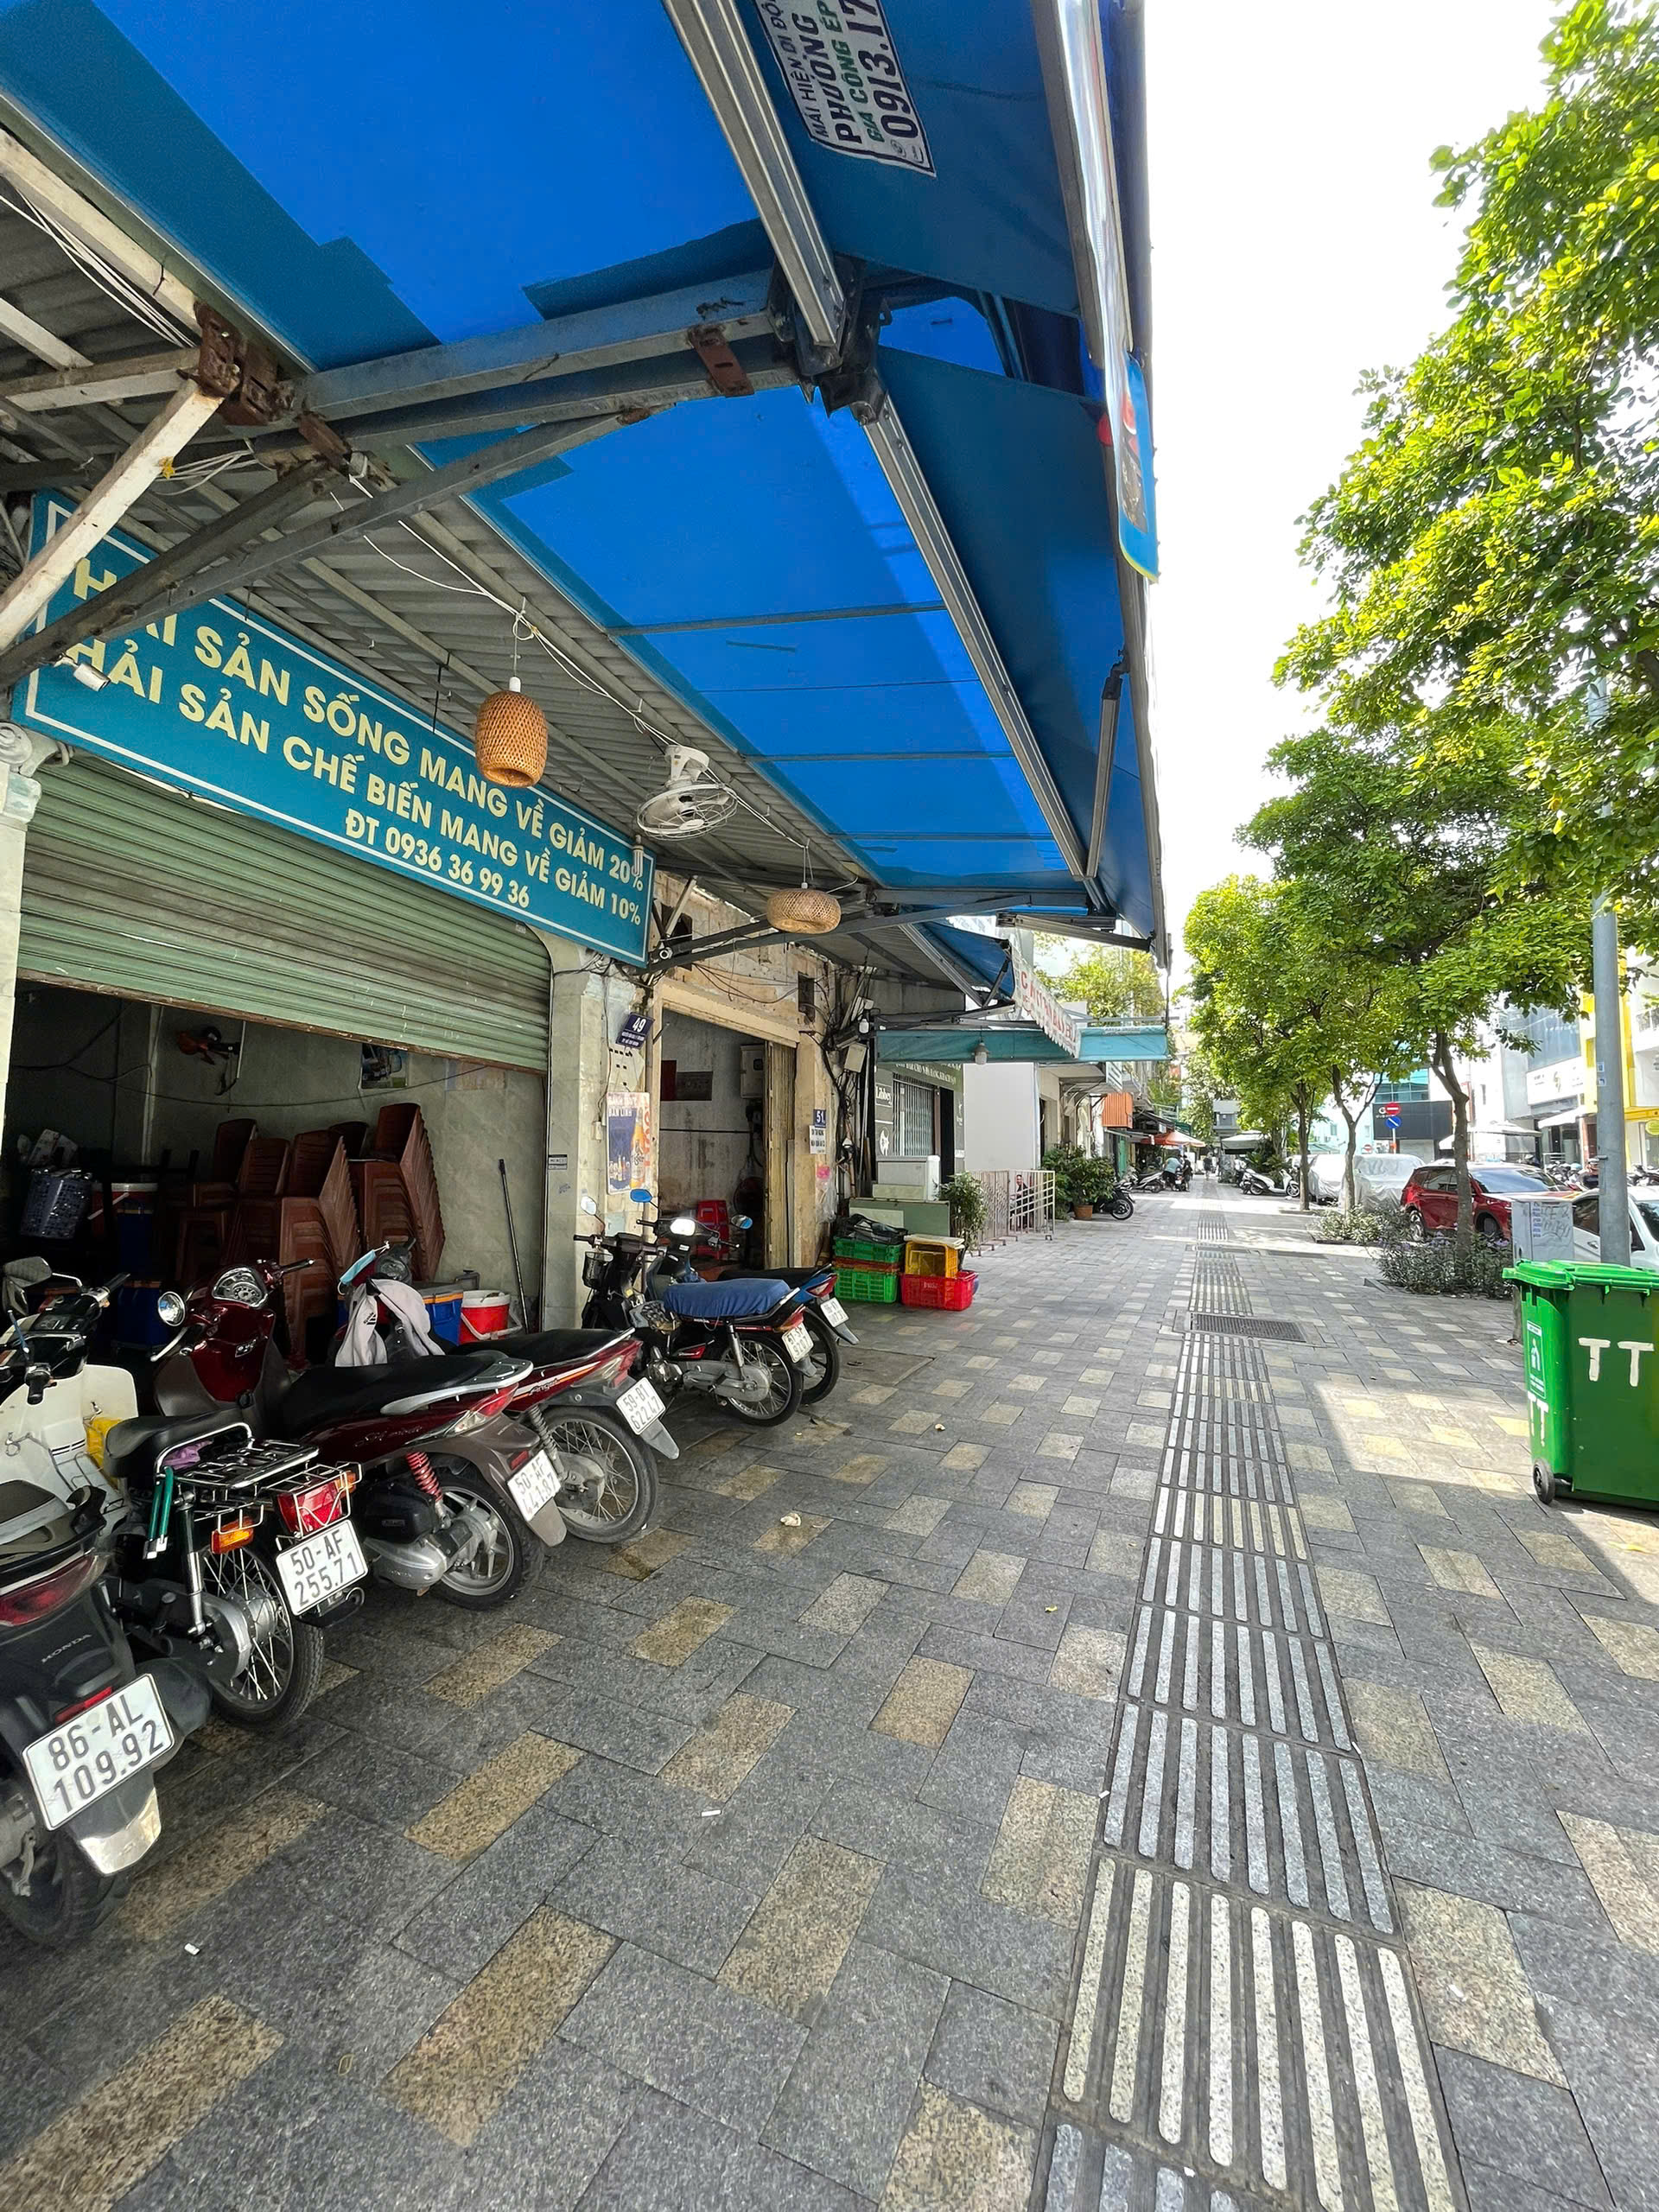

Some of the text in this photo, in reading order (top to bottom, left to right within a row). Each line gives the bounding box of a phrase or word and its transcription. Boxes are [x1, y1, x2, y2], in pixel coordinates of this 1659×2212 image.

[761, 0, 830, 138] MÁI HIÊN DI ĐỘ
[791, 13, 862, 144] PHƯƠNG
[831, 39, 869, 105] CÔNG
[861, 111, 885, 143] GIA
[74, 557, 177, 646] HI
[194, 626, 290, 707] SẢN
[302, 685, 410, 766] SỐNG
[419, 747, 508, 818] MANG
[516, 798, 545, 839] VỀ
[549, 823, 605, 871] GIẢM
[179, 683, 270, 754] SẢN
[283, 736, 365, 795] CHẾ
[366, 773, 432, 829] BIẾN
[440, 810, 518, 867] MANG
[524, 848, 550, 884] VỀ
[555, 868, 606, 909] GIẢM
[611, 893, 641, 925] 10%
[345, 808, 531, 908] ĐT 0936 36 99 36
[632, 1017, 646, 1033] 49
[816, 1110, 824, 1123] 51
[622, 1383, 650, 1412] 59-B1
[630, 1396, 662, 1430] 622.47
[289, 1530, 343, 1577] 50-AF
[294, 1553, 360, 1606] 255.71
[41, 1634, 92, 1664] HONDA
[48, 1694, 143, 1771] 86-AL
[54, 1719, 164, 1815] 109.92
